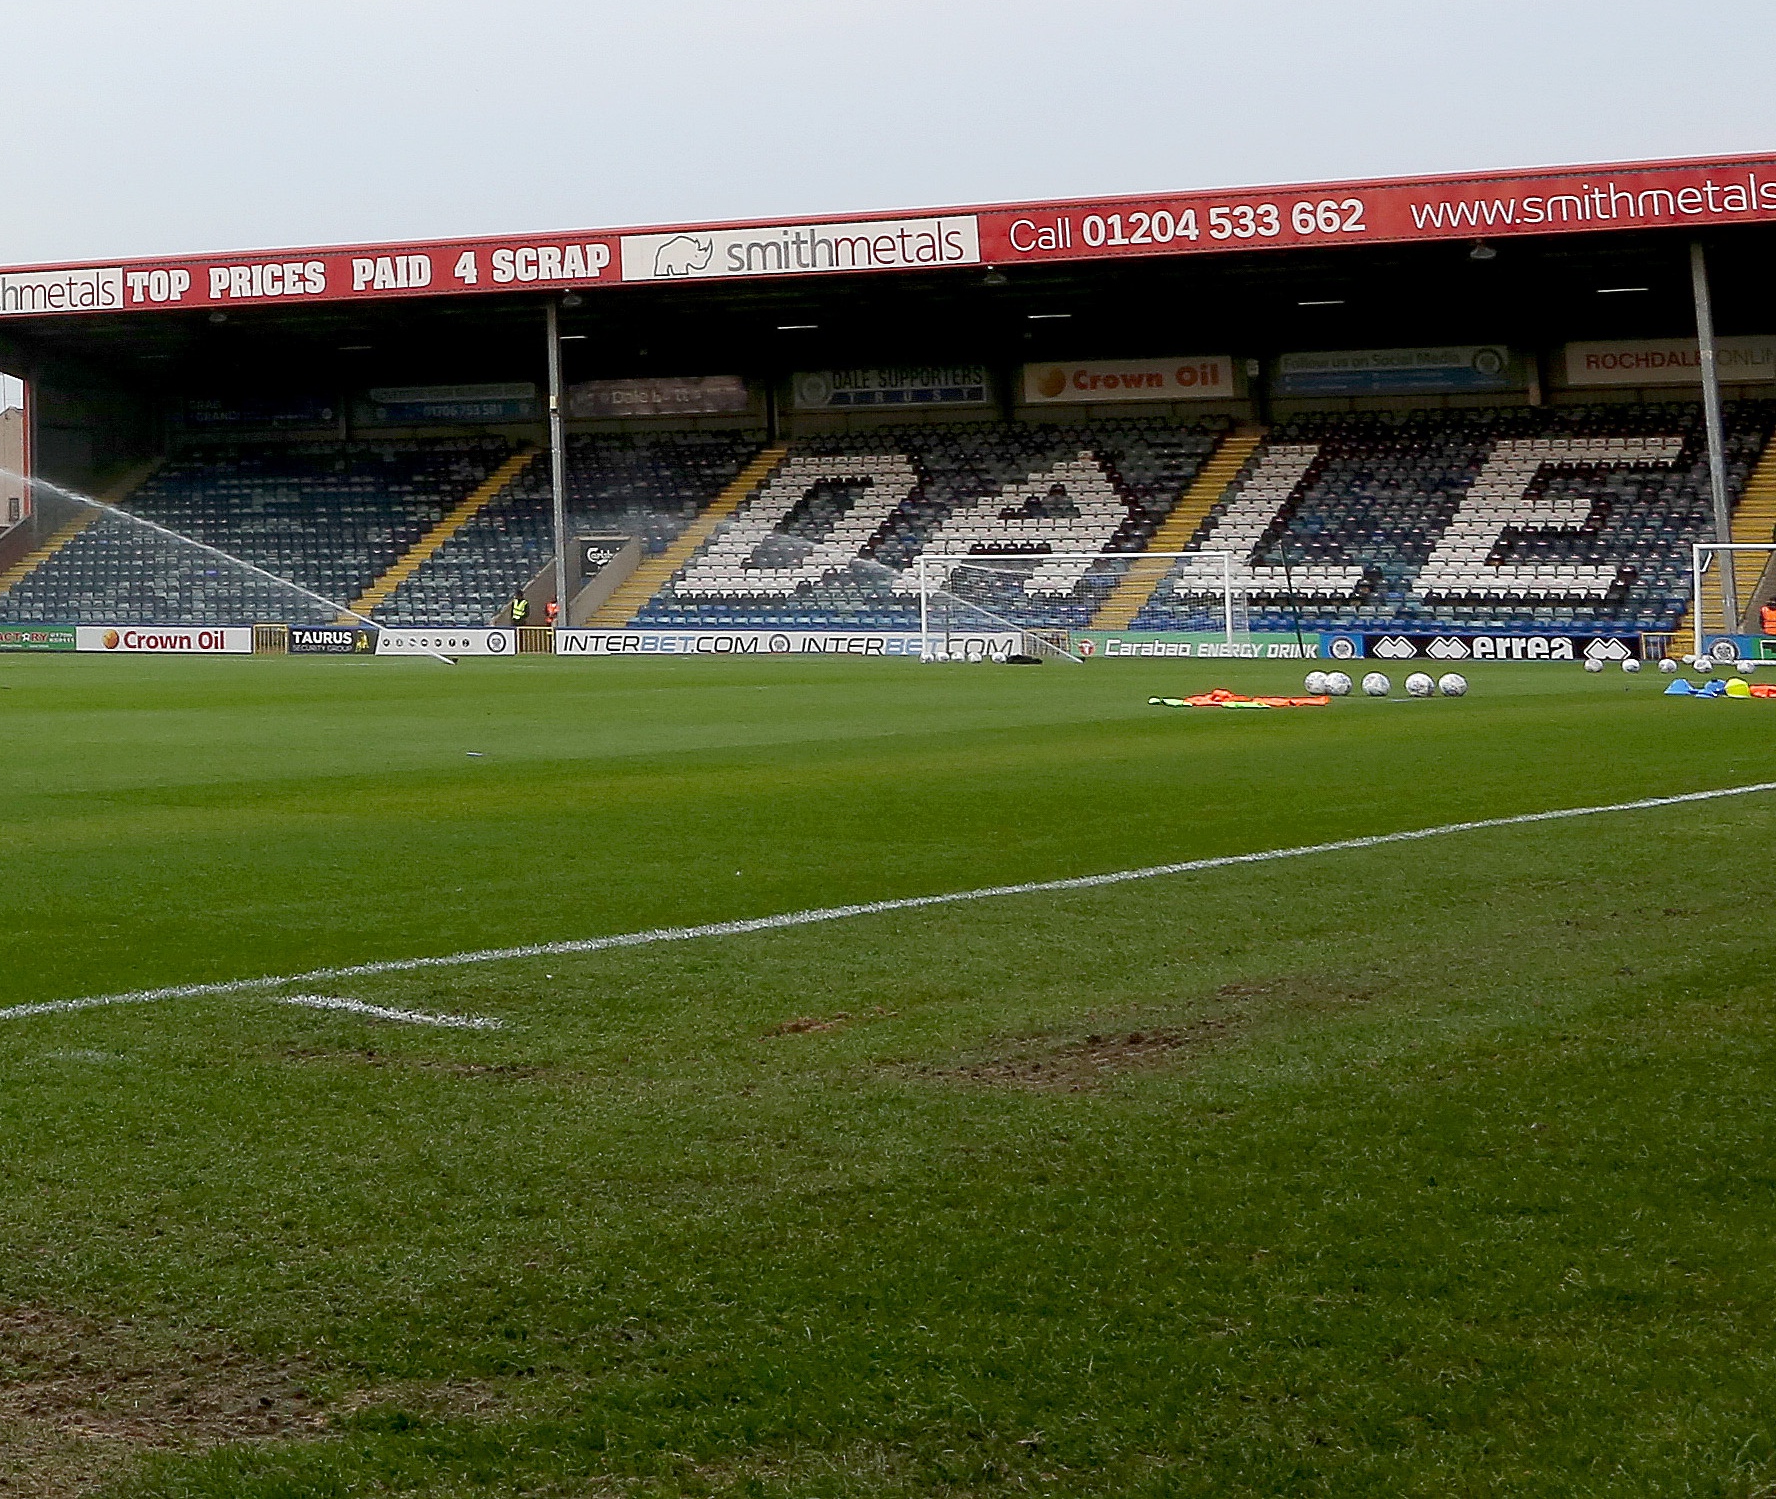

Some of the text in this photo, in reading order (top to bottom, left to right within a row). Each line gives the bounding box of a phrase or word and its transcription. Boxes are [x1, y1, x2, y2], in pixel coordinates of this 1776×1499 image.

[1009, 198, 1366, 252] Call 01204 533 662
[727, 221, 964, 272] smithmetals
[126, 243, 610, 303] TOP PRICES PAID 4 SCRAP
[1073, 363, 1220, 391] Crown Oil
[123, 629, 225, 650] Crown Oil
[292, 630, 353, 645] TAURUS
[563, 634, 759, 654] INTERBET.COM
[1104, 638, 1193, 657] Carabao
[1471, 635, 1574, 660] errea
